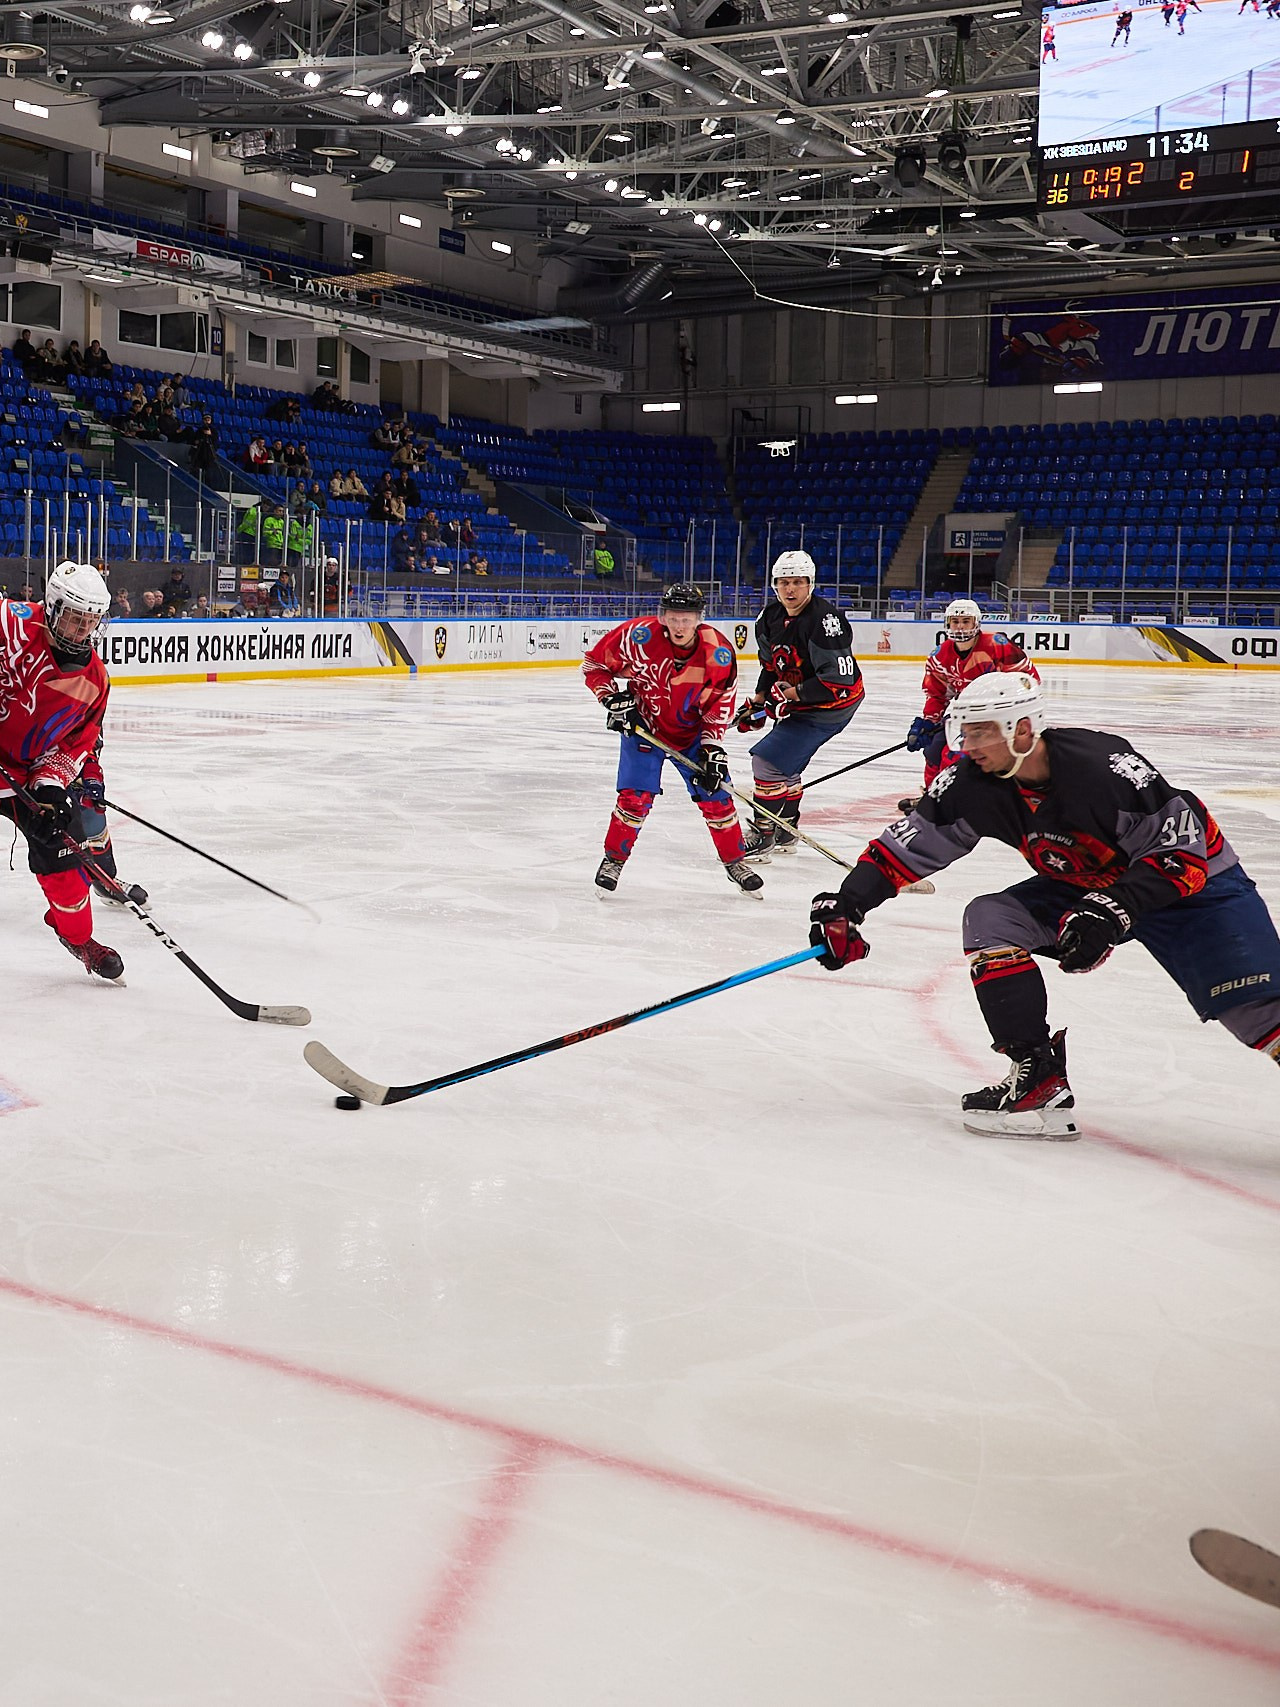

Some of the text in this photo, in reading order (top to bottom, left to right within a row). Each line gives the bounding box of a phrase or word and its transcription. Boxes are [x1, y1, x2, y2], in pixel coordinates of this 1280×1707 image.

[1059, 142, 1102, 158] ЗВЕЗДА
[1146, 131, 1209, 157] 11:34
[1052, 172, 1070, 188] 11
[1083, 166, 1122, 185] 0:19
[1127, 161, 1145, 185] 2
[1179, 171, 1195, 189] 2
[1046, 188, 1069, 204] 36
[1090, 184, 1121, 200] 1:41
[149, 246, 190, 266] SPAR
[289, 275, 345, 302] TANK
[212, 330, 222, 345] 10
[980, 614, 1008, 622] PARI
[467, 625, 504, 645] ЛИГА
[537, 630, 556, 640] НИЖНИЙ
[94, 627, 353, 665] ЕРСКАЯ ХОККЕЙНАЯ ЛИГА
[468, 649, 503, 660] СИЛЬНЫХ
[537, 642, 560, 651] НОВГОРОД
[837, 656, 854, 675] 88
[1159, 809, 1200, 847] 34
[1082, 892, 1132, 933] BAUER
[1210, 973, 1271, 998] BAUER
